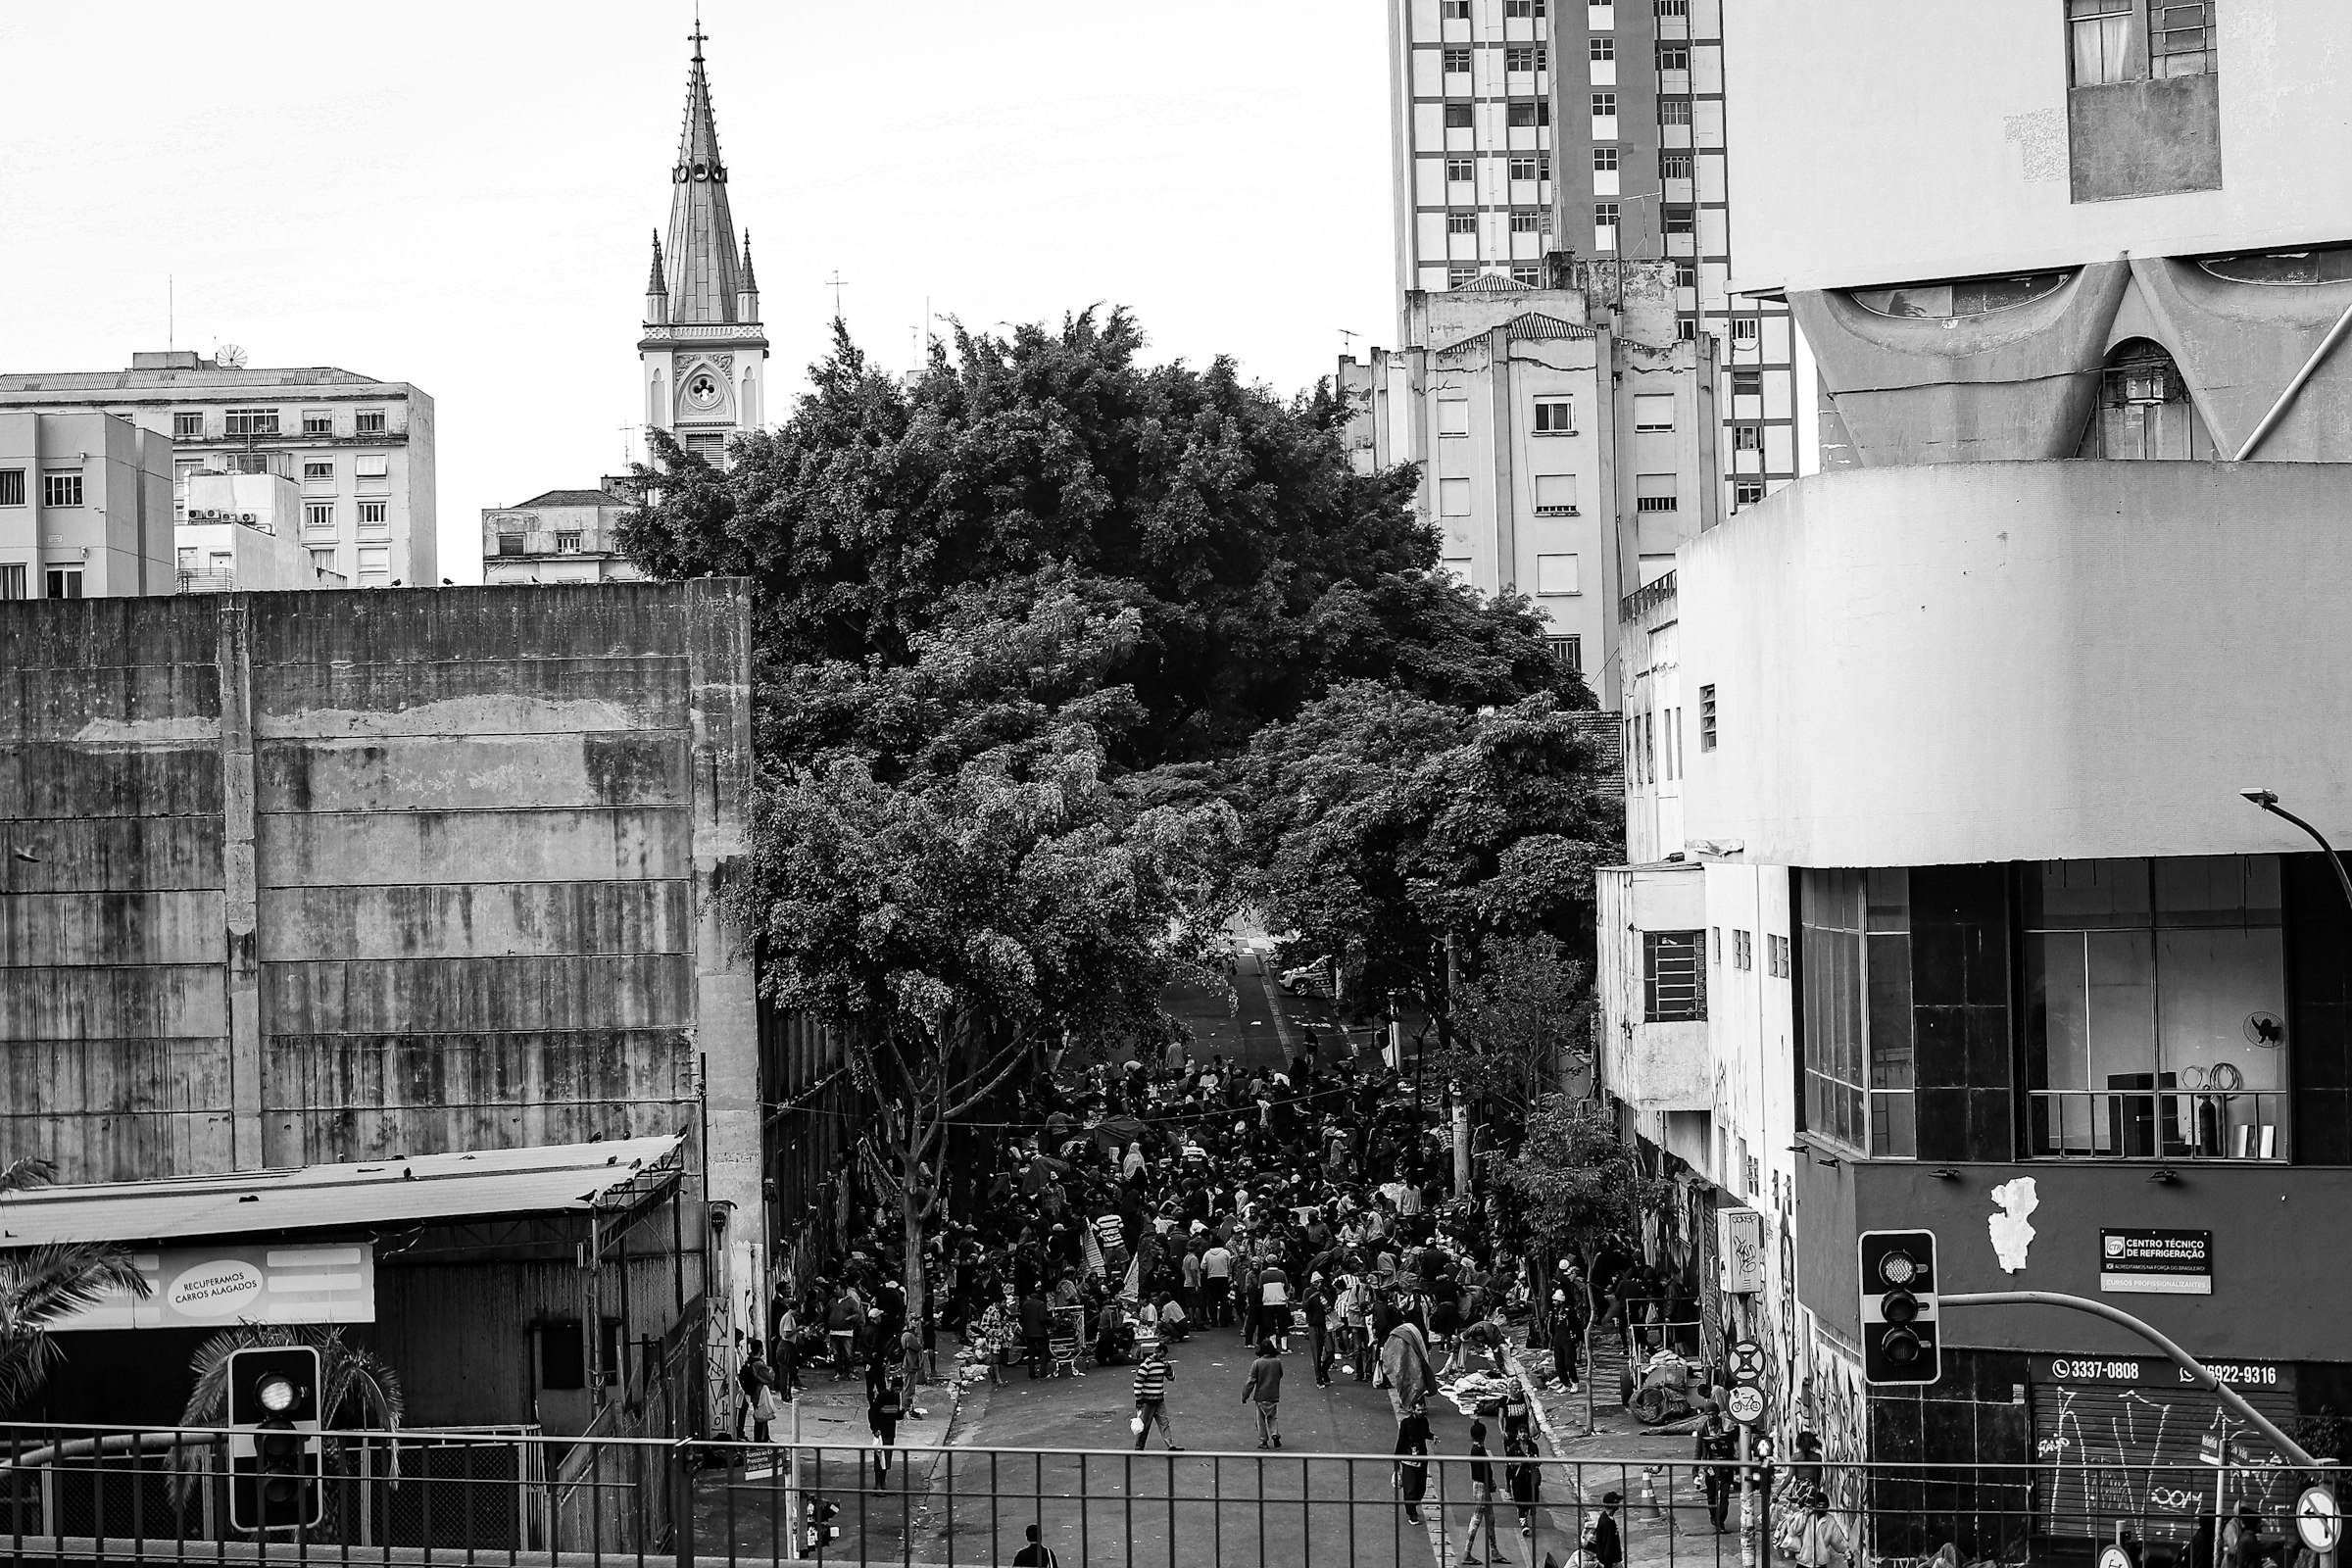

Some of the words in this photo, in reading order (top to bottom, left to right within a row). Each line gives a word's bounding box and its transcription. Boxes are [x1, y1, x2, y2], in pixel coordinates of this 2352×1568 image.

[2126, 1239, 2163, 1249] CENTRO
[2164, 1238, 2205, 1250] TÉCNICO
[2126, 1249, 2139, 1257] DE
[2139, 1248, 2206, 1260] REFRIGERAÇÃO
[175, 1290, 209, 1303] CARROS
[211, 1280, 258, 1297] ALAGADOS
[183, 1272, 245, 1292] RECUPERAMOS
[2133, 1280, 2206, 1289] PROFISSIONALIZANTES
[2071, 1360, 2139, 1380] 3337-0808
[2200, 1364, 2277, 1384] 6922-9316
